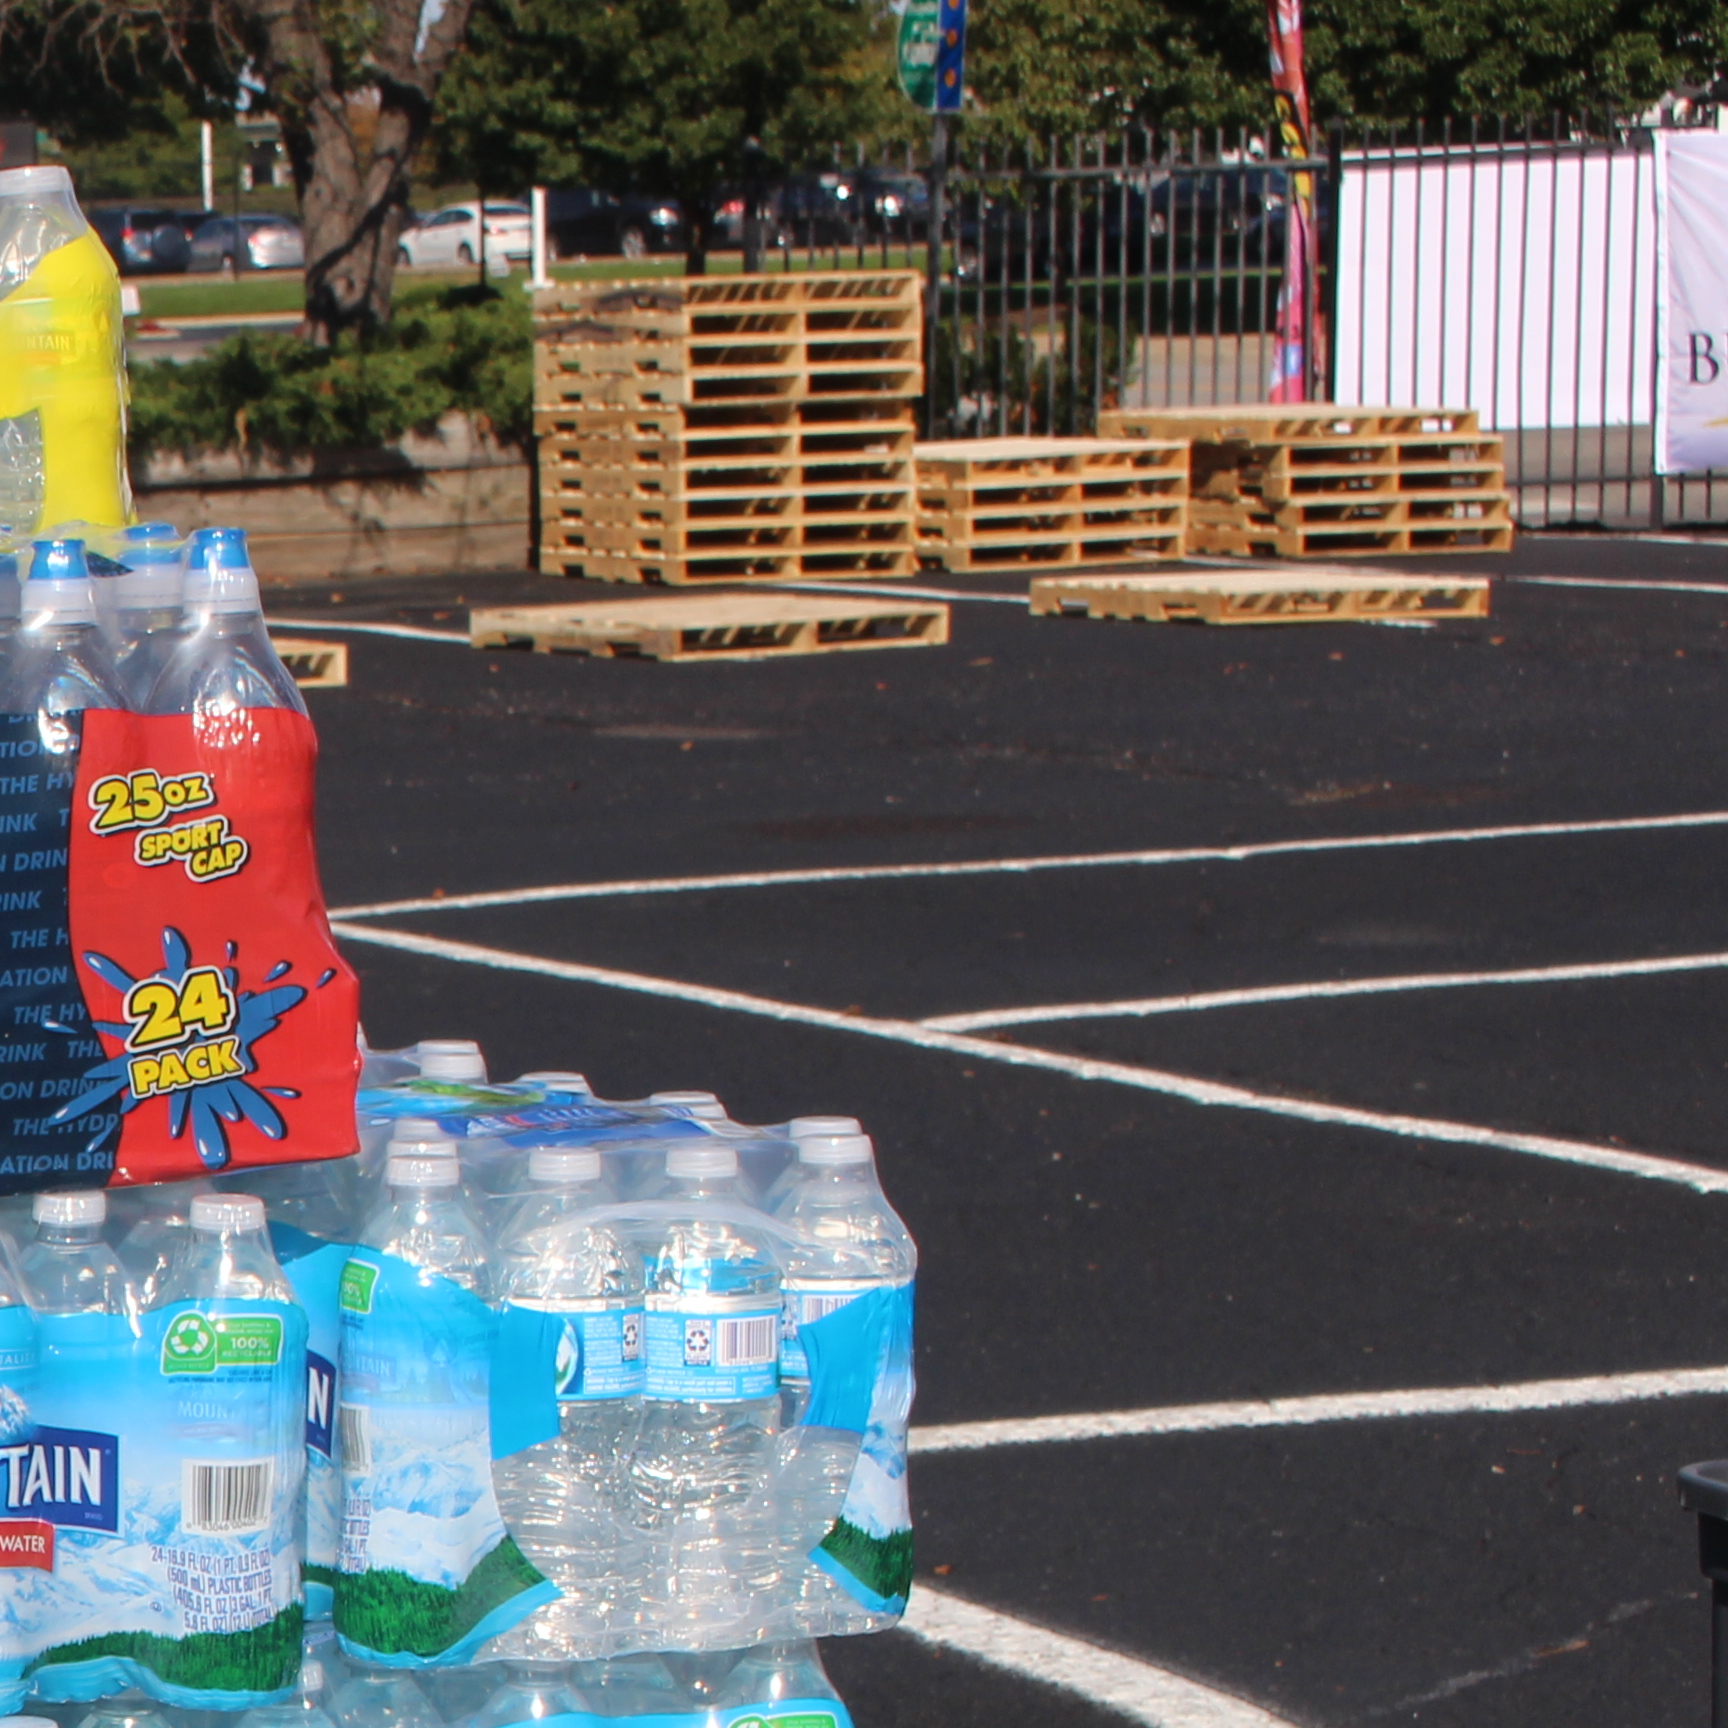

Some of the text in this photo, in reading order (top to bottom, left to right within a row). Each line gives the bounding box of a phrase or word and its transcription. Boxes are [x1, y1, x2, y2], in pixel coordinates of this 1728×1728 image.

[141, 820, 223, 860] SPORT
[191, 841, 243, 876] CAP
[131, 971, 229, 1046] 24
[132, 1039, 243, 1094] PACK
[230, 1336, 270, 1349] 100%
[0, 1533, 46, 1555] WATER
